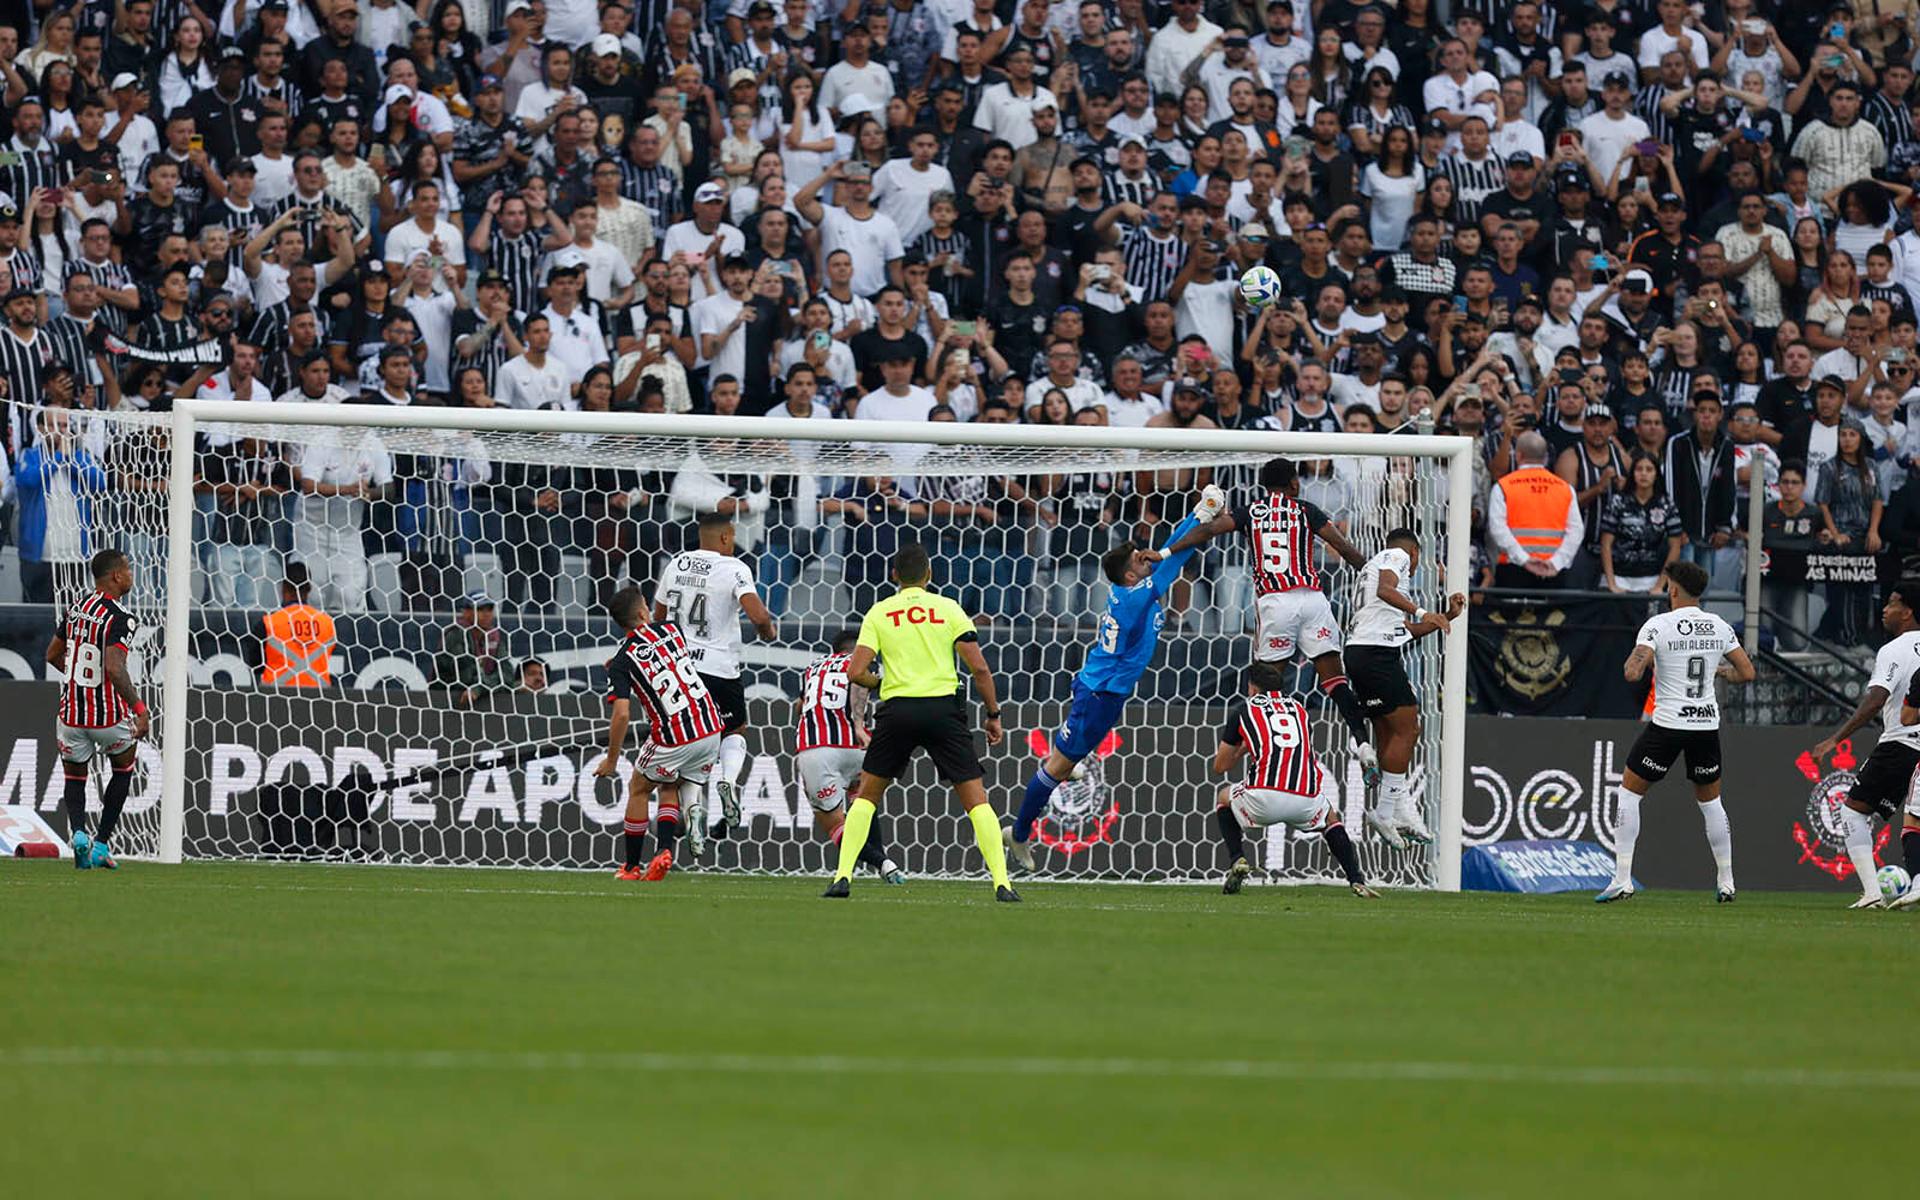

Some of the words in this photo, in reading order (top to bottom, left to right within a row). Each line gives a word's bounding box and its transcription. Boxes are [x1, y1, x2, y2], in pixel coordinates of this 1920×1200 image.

[1262, 532, 1289, 573] 5
[1829, 567, 1877, 582] MINAS
[667, 590, 708, 637] 34
[886, 607, 945, 627] TCL
[1694, 622, 1715, 631] SCCP
[1667, 641, 1687, 651] YURI
[1688, 639, 1724, 651] ALBERTO
[651, 656, 707, 716] 29
[1687, 657, 1705, 698] 9
[1269, 713, 1300, 748] 9
[816, 784, 837, 799] abc
